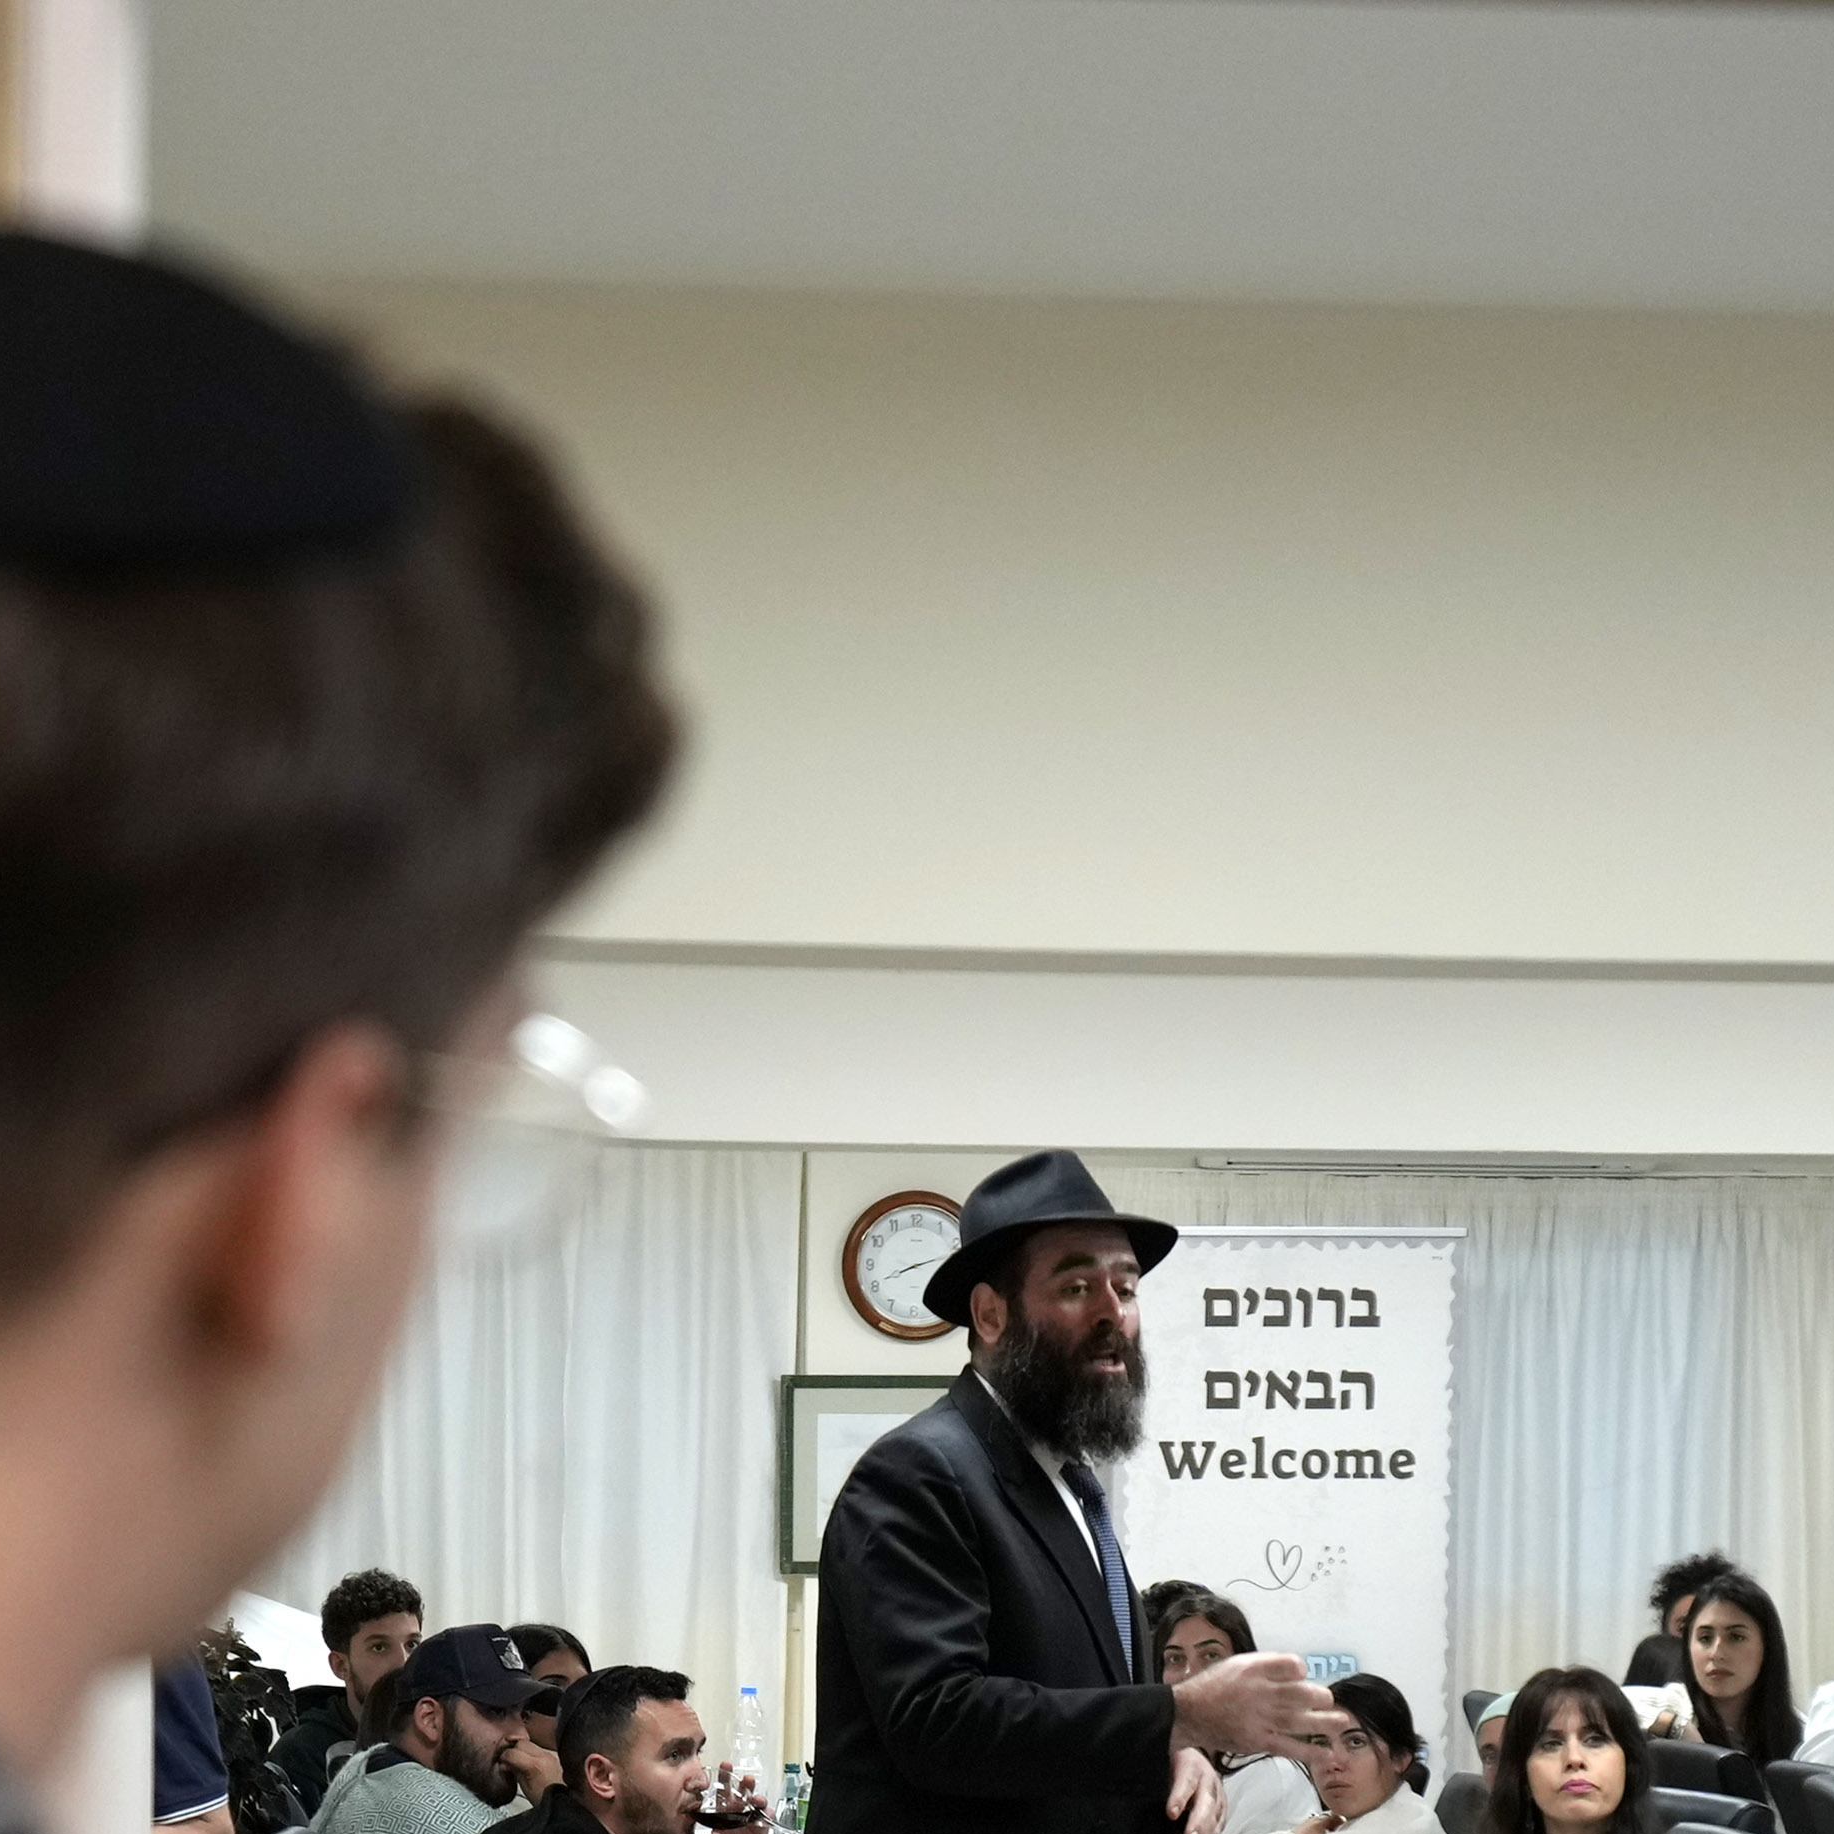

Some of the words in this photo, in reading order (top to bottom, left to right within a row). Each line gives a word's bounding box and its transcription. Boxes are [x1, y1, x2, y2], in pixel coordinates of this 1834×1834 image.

[889, 1219, 899, 1232] 11
[911, 1213, 923, 1227] 12
[937, 1221, 943, 1233] 1
[871, 1235, 884, 1248] 10
[866, 1258, 875, 1271] 9
[870, 1280, 879, 1293] 8
[887, 1299, 895, 1312] 7
[909, 1305, 919, 1318] 6
[1203, 1287, 1381, 1328] ברוכים
[1204, 1369, 1376, 1410] הבאים
[1158, 1436, 1416, 1480] Welcome
